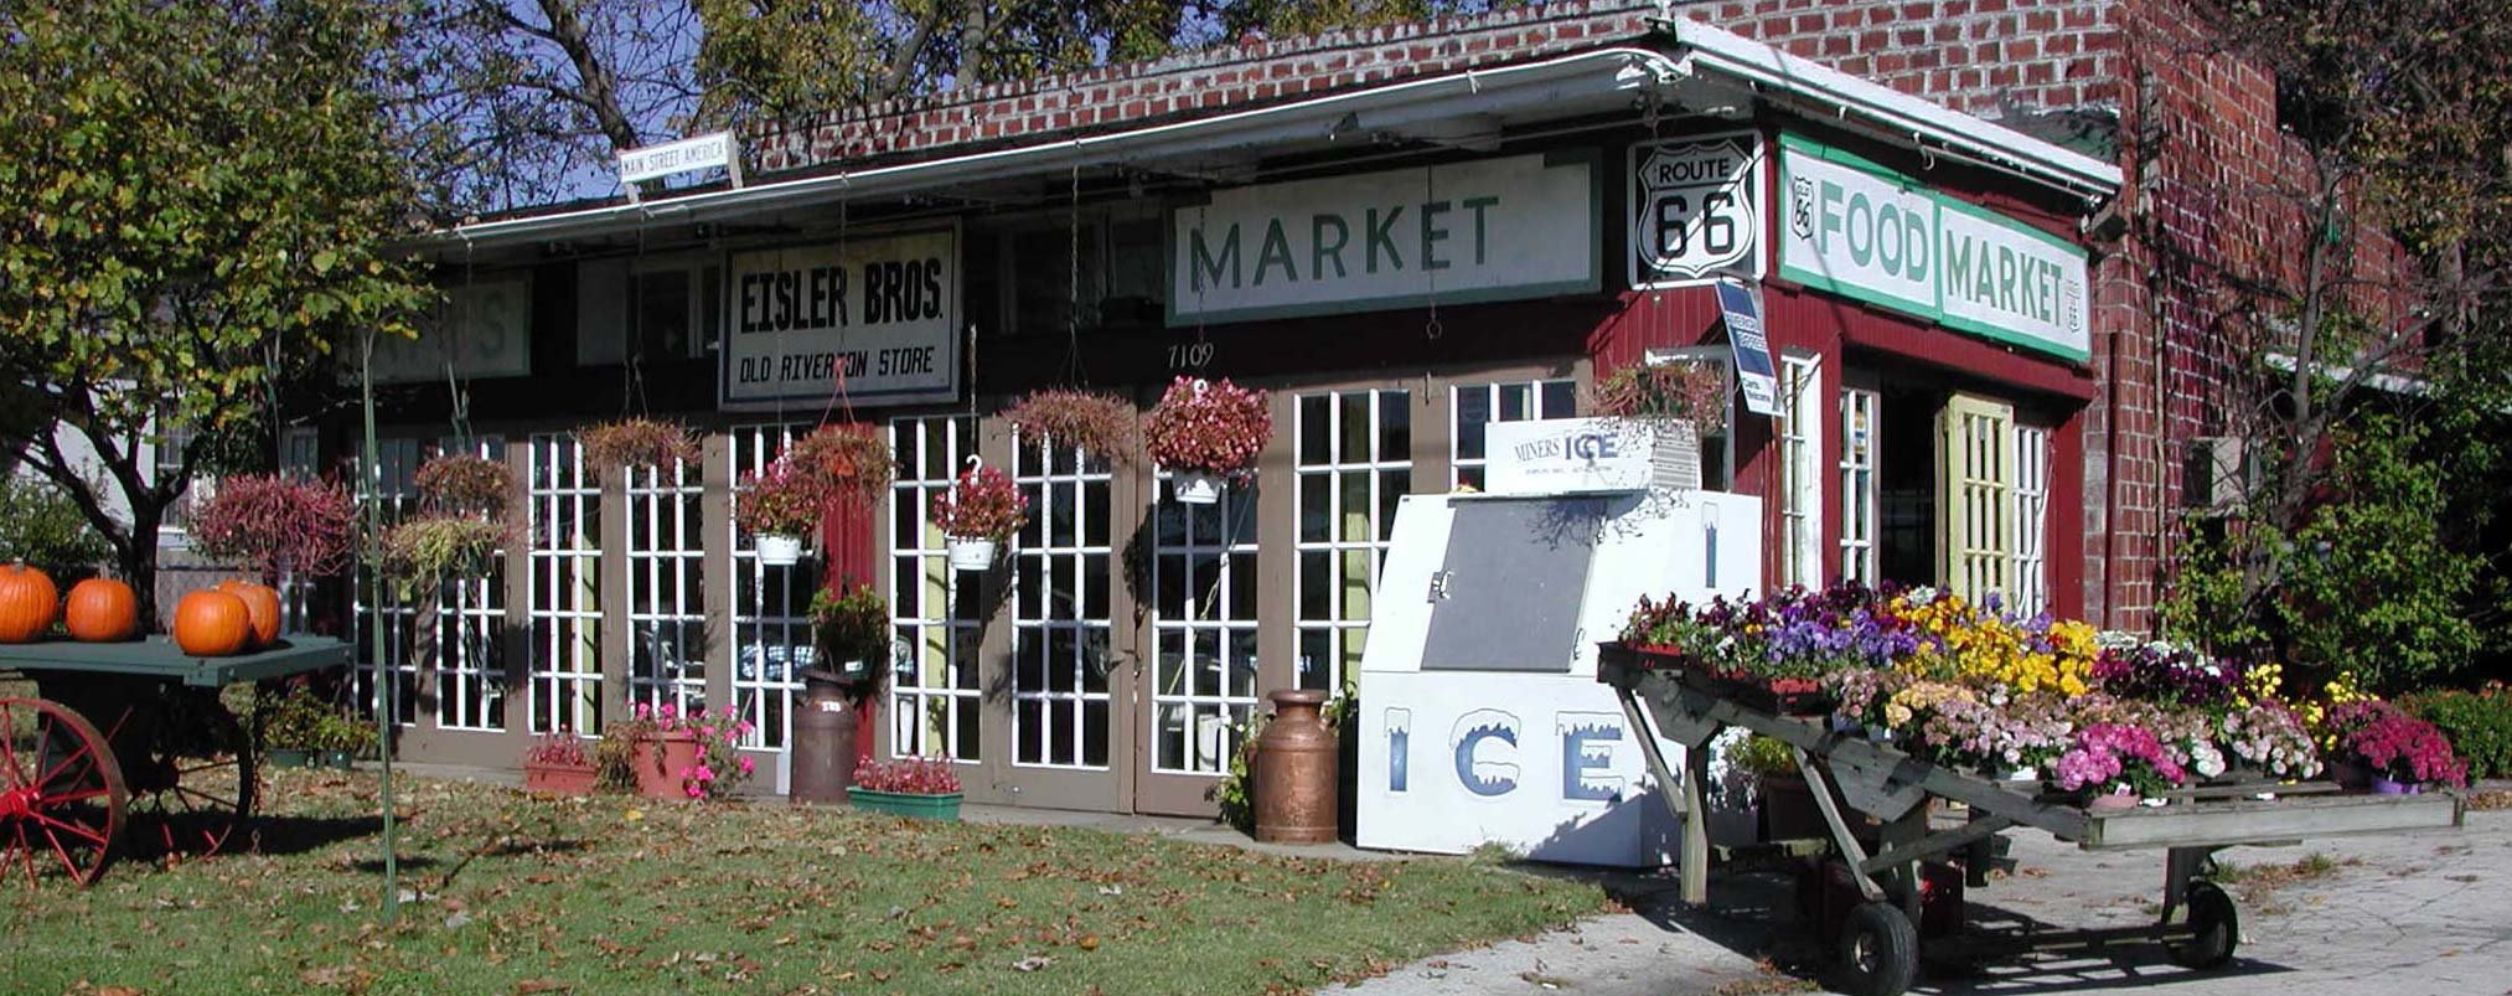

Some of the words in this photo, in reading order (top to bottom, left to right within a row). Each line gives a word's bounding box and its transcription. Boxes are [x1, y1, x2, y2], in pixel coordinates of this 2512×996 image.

[623, 157, 644, 173] MAIN
[649, 147, 680, 171] STREET
[684, 140, 724, 162] AMERICA
[1660, 157, 1730, 182] ROUTE
[1656, 191, 1735, 259] 66
[1795, 199, 1811, 229] 66
[1820, 180, 1929, 283] FOOD
[1190, 196, 1499, 293] MARKET
[741, 265, 848, 334] EISLER
[864, 257, 943, 325] BROS.
[1946, 229, 2062, 328] MARKET
[740, 356, 771, 383] OLD
[878, 346, 935, 376] STORE
[1169, 343, 1214, 369] 7109
[1515, 437, 1560, 462] MINERS
[1565, 431, 1619, 460] ICE
[1384, 706, 1625, 802] ICE
